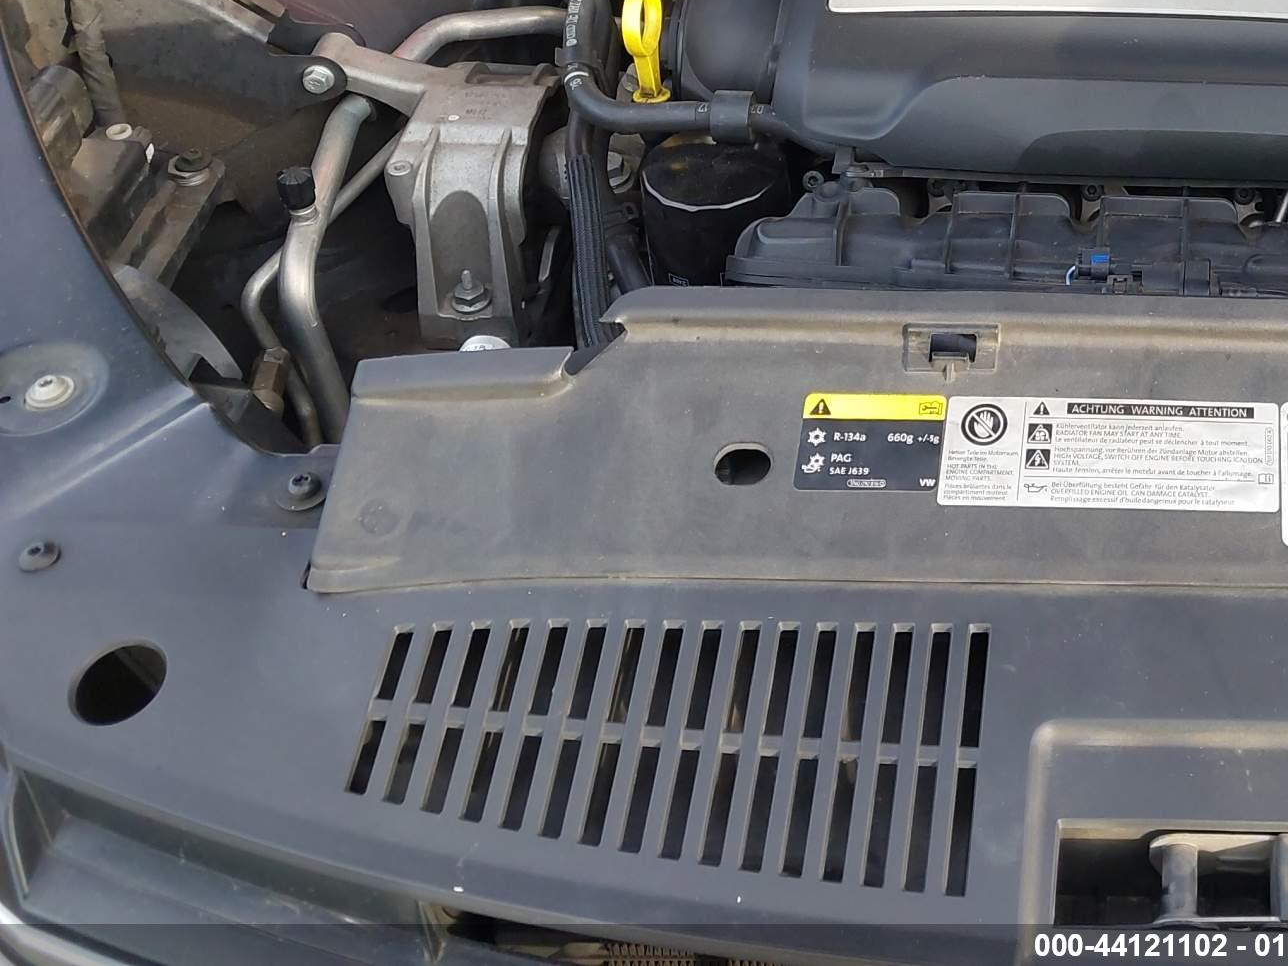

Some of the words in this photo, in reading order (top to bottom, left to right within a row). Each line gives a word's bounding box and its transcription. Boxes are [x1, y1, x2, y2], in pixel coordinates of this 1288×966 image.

[1072, 405, 1124, 413] ACHTUNG
[1131, 406, 1183, 415] WARNING
[1189, 408, 1246, 417] ATTENTION
[833, 433, 866, 441] R-134a
[887, 433, 913, 444] 660g
[830, 453, 852, 463] PAG
[829, 467, 846, 475] SAE
[848, 467, 870, 475] J639
[919, 479, 936, 487] VW
